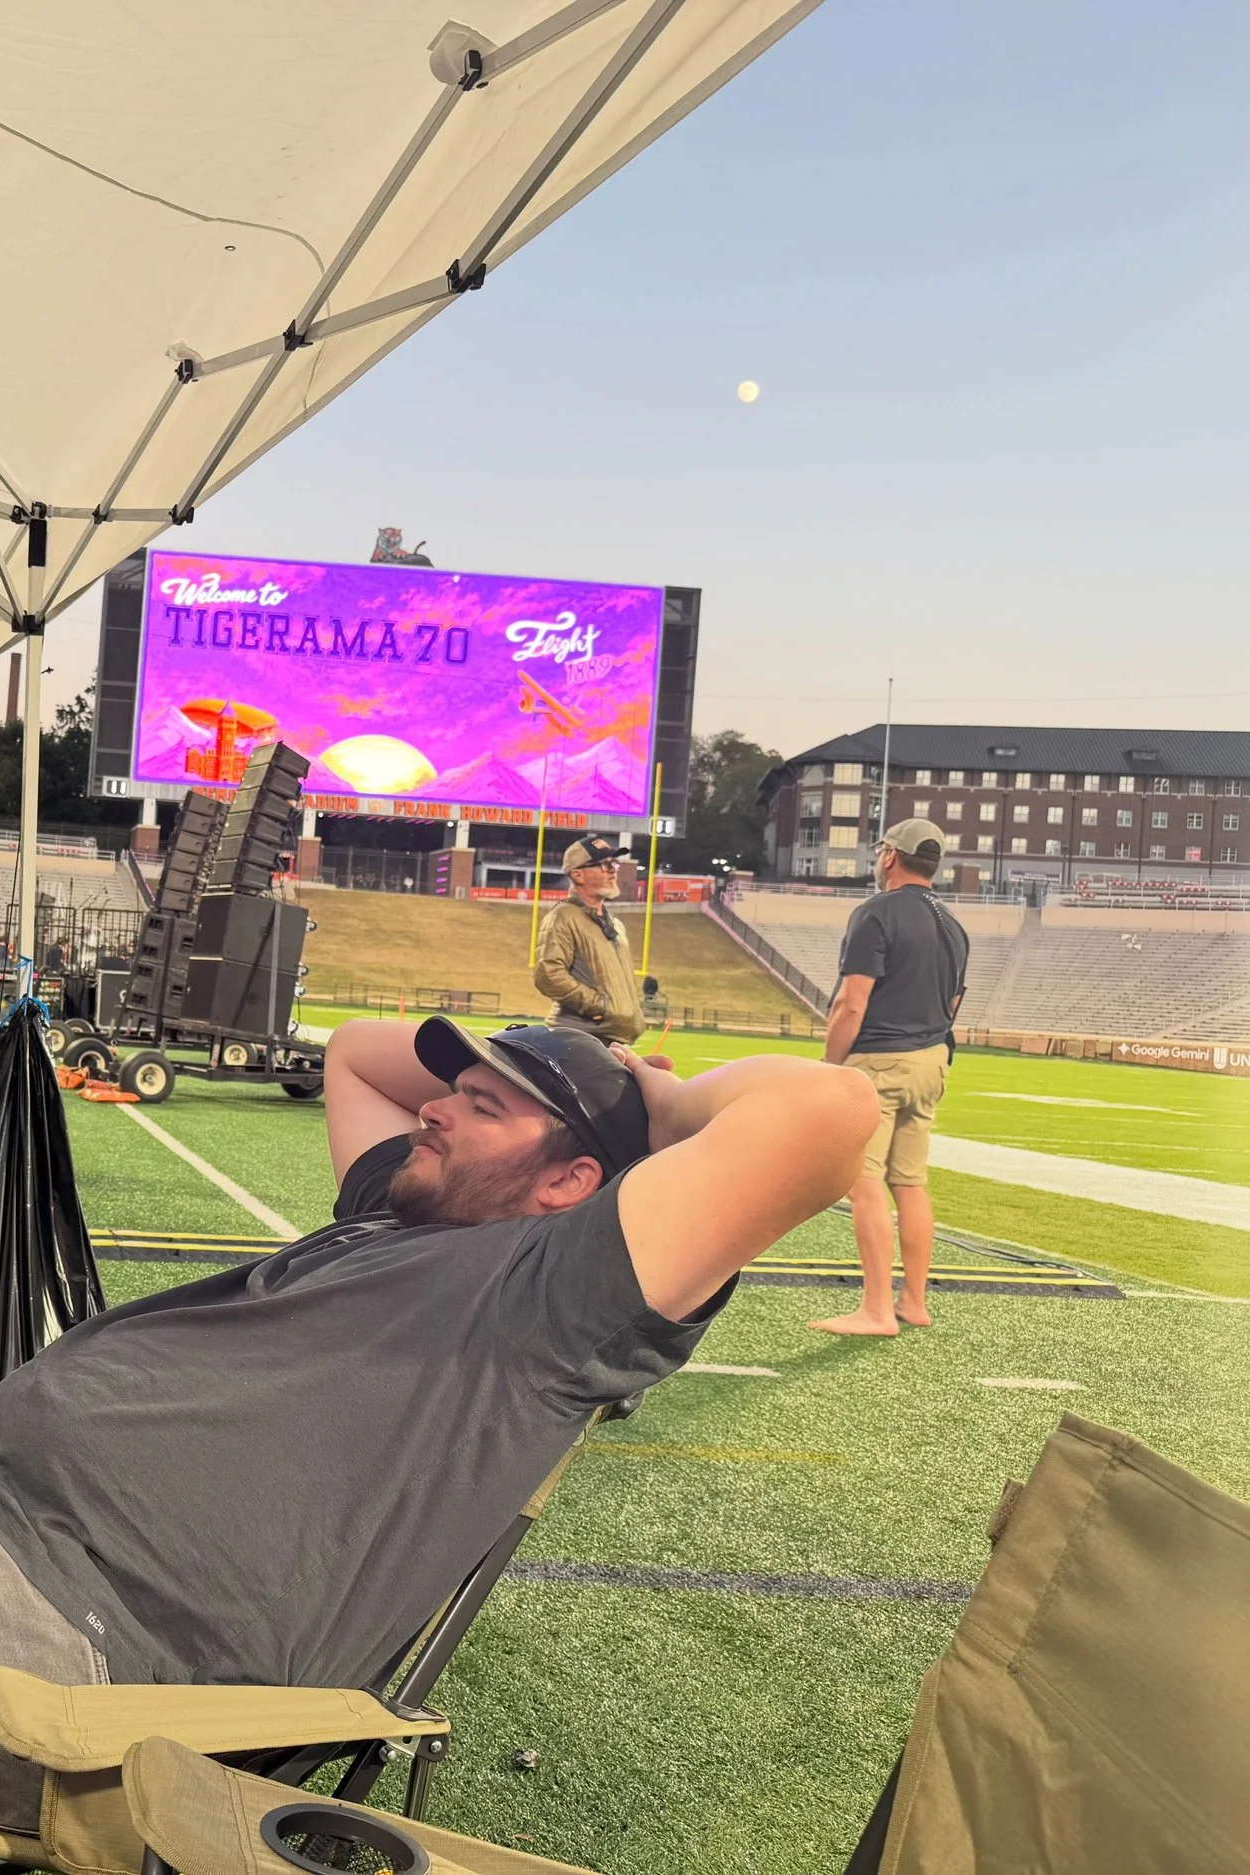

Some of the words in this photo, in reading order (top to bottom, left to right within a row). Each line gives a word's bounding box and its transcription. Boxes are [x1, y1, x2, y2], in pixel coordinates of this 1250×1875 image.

[161, 573, 258, 605] Welcome
[259, 581, 288, 605] to
[164, 605, 402, 663] TIGERAMA
[415, 623, 471, 666] 70
[506, 611, 601, 663] Flight
[296, 794, 359, 811] ADIUM
[394, 801, 452, 818] FRANK
[461, 805, 534, 824] HOWARD
[1131, 1044, 1170, 1058] Google
[1171, 1047, 1210, 1060] Gemini
[86, 1611, 105, 1635] 1620
